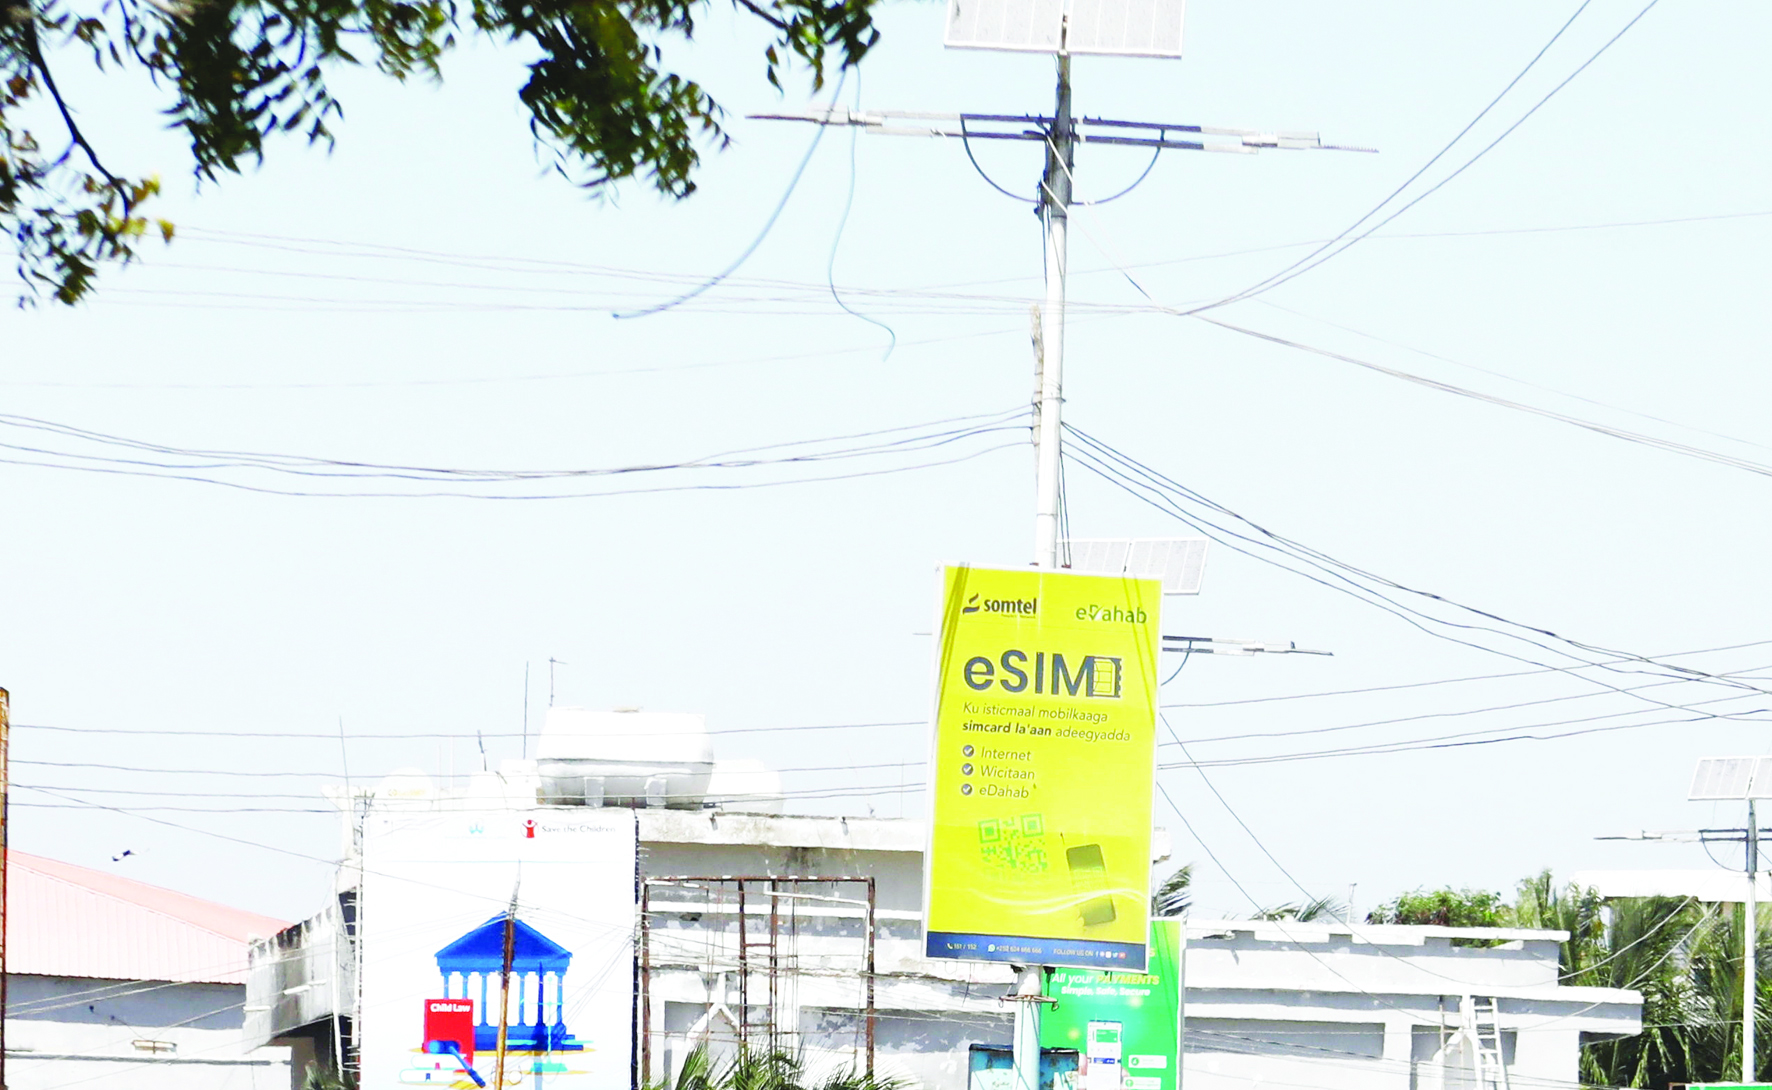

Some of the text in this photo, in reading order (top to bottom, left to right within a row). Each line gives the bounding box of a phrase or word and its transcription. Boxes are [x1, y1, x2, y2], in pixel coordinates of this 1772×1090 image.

[984, 597, 1037, 614] somtel
[964, 649, 1095, 698] eSIM
[963, 702, 1108, 725] Ku isticmaal mobilkaaga
[962, 720, 1131, 742] simcard la'aan adeegyadda
[981, 747, 1031, 761] Internet
[980, 765, 1035, 780] Wicitaan
[979, 784, 1029, 798] eDahab
[541, 824, 616, 833] Save the Children
[1051, 973, 1160, 988] All your PAYMENTS
[1119, 987, 1151, 996] Secure
[430, 1003, 471, 1012] Child Law
